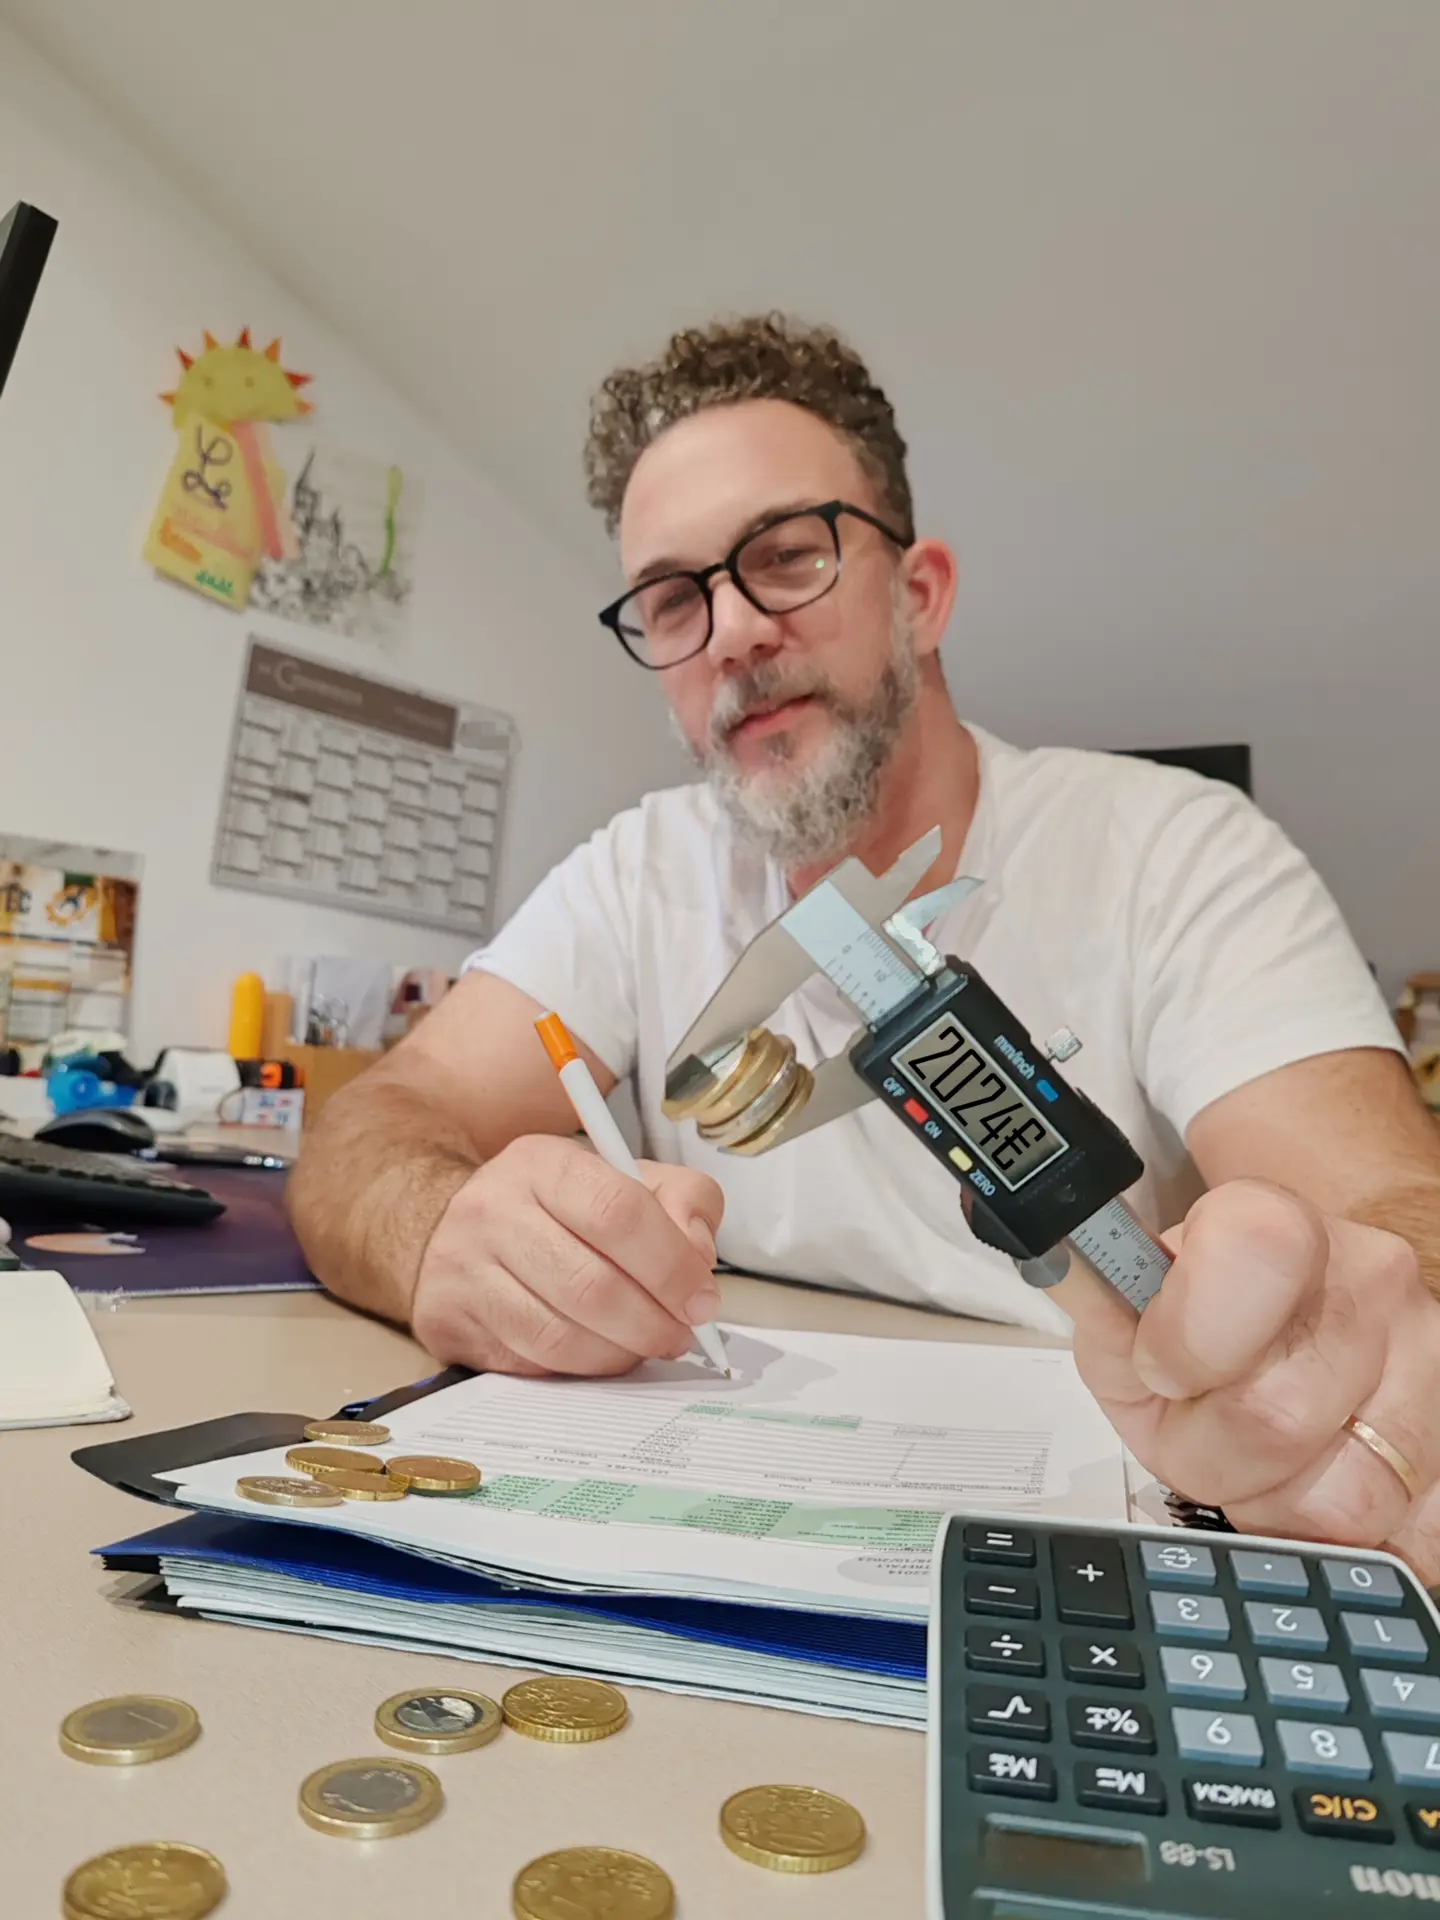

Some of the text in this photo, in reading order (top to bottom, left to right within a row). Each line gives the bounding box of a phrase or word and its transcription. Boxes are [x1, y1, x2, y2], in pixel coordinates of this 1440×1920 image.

[994, 1034, 1036, 1080] mm/inch
[882, 1077, 942, 1139] OFF ON
[907, 1025, 1047, 1172] 2024€
[968, 1170, 996, 1196] ZERO
[1109, 1228, 1148, 1270] 90 100
[1349, 1567, 1373, 1588] 0
[1176, 1598, 1201, 1622] 3
[1271, 1608, 1299, 1632] 2
[1373, 1619, 1393, 1644] 1
[1190, 1654, 1214, 1680] 6
[1290, 1665, 1315, 1691] 5
[1391, 1676, 1416, 1702] 4
[1206, 1717, 1232, 1746] 9
[1308, 1728, 1339, 1760] 8
[1417, 1808, 1440, 1829] A
